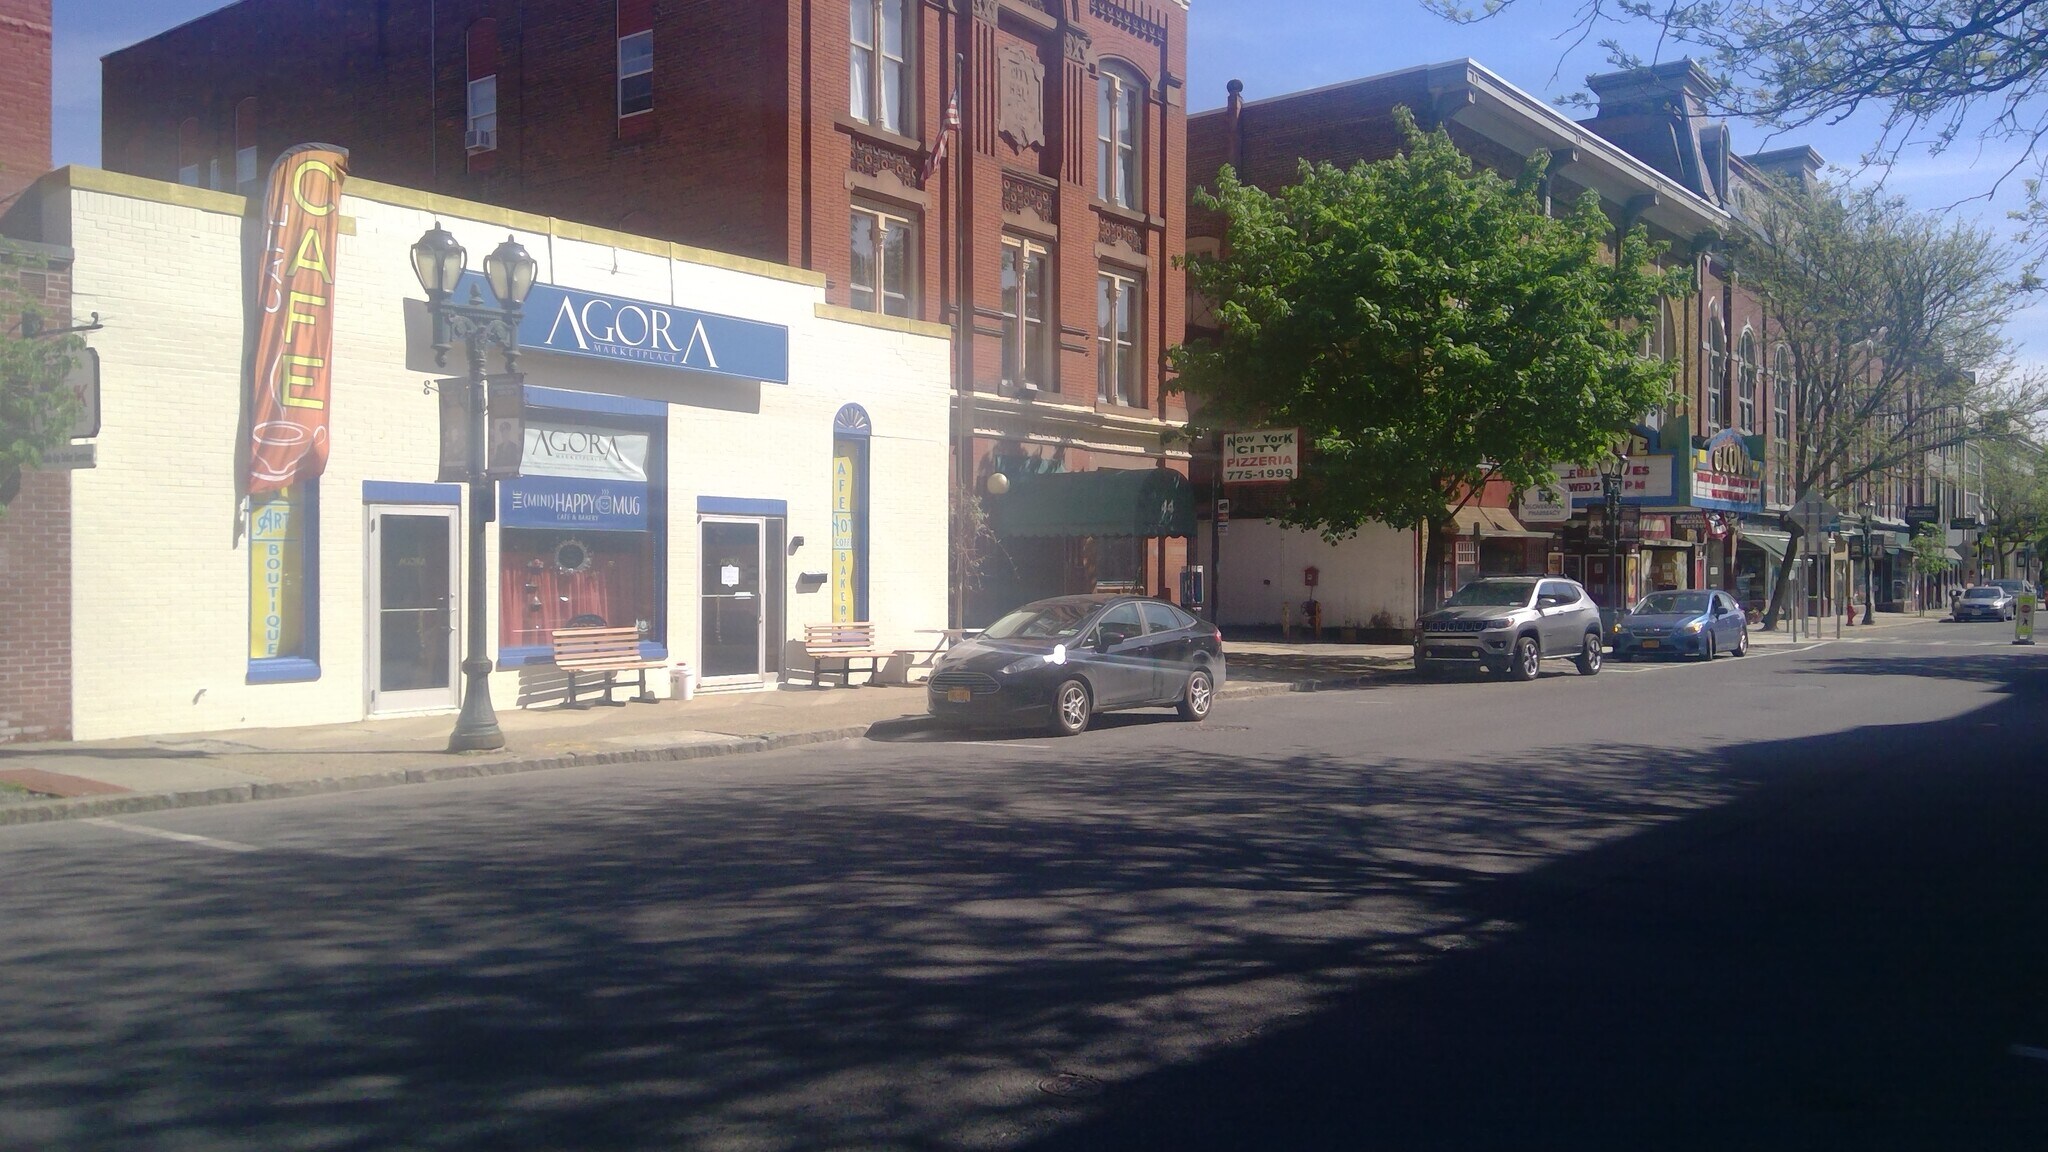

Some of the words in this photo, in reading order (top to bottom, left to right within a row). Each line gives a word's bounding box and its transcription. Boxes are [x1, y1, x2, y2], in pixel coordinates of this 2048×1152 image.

[282, 159, 335, 410] CAFE
[543, 295, 719, 368] AGORA
[593, 343, 677, 363] MARKETPLACE
[531, 429, 623, 461] AGORA
[1236, 444, 1282, 454] CITY
[1226, 455, 1293, 467] PIZZERIA
[1227, 468, 1293, 481] 775-1999
[1568, 482, 1591, 492] WED
[512, 490, 523, 510] THE
[523, 493, 555, 509] (MINI)
[555, 493, 597, 514] HAPPY
[613, 495, 640, 515] MUG
[266, 544, 281, 655] BOUTIQUE
